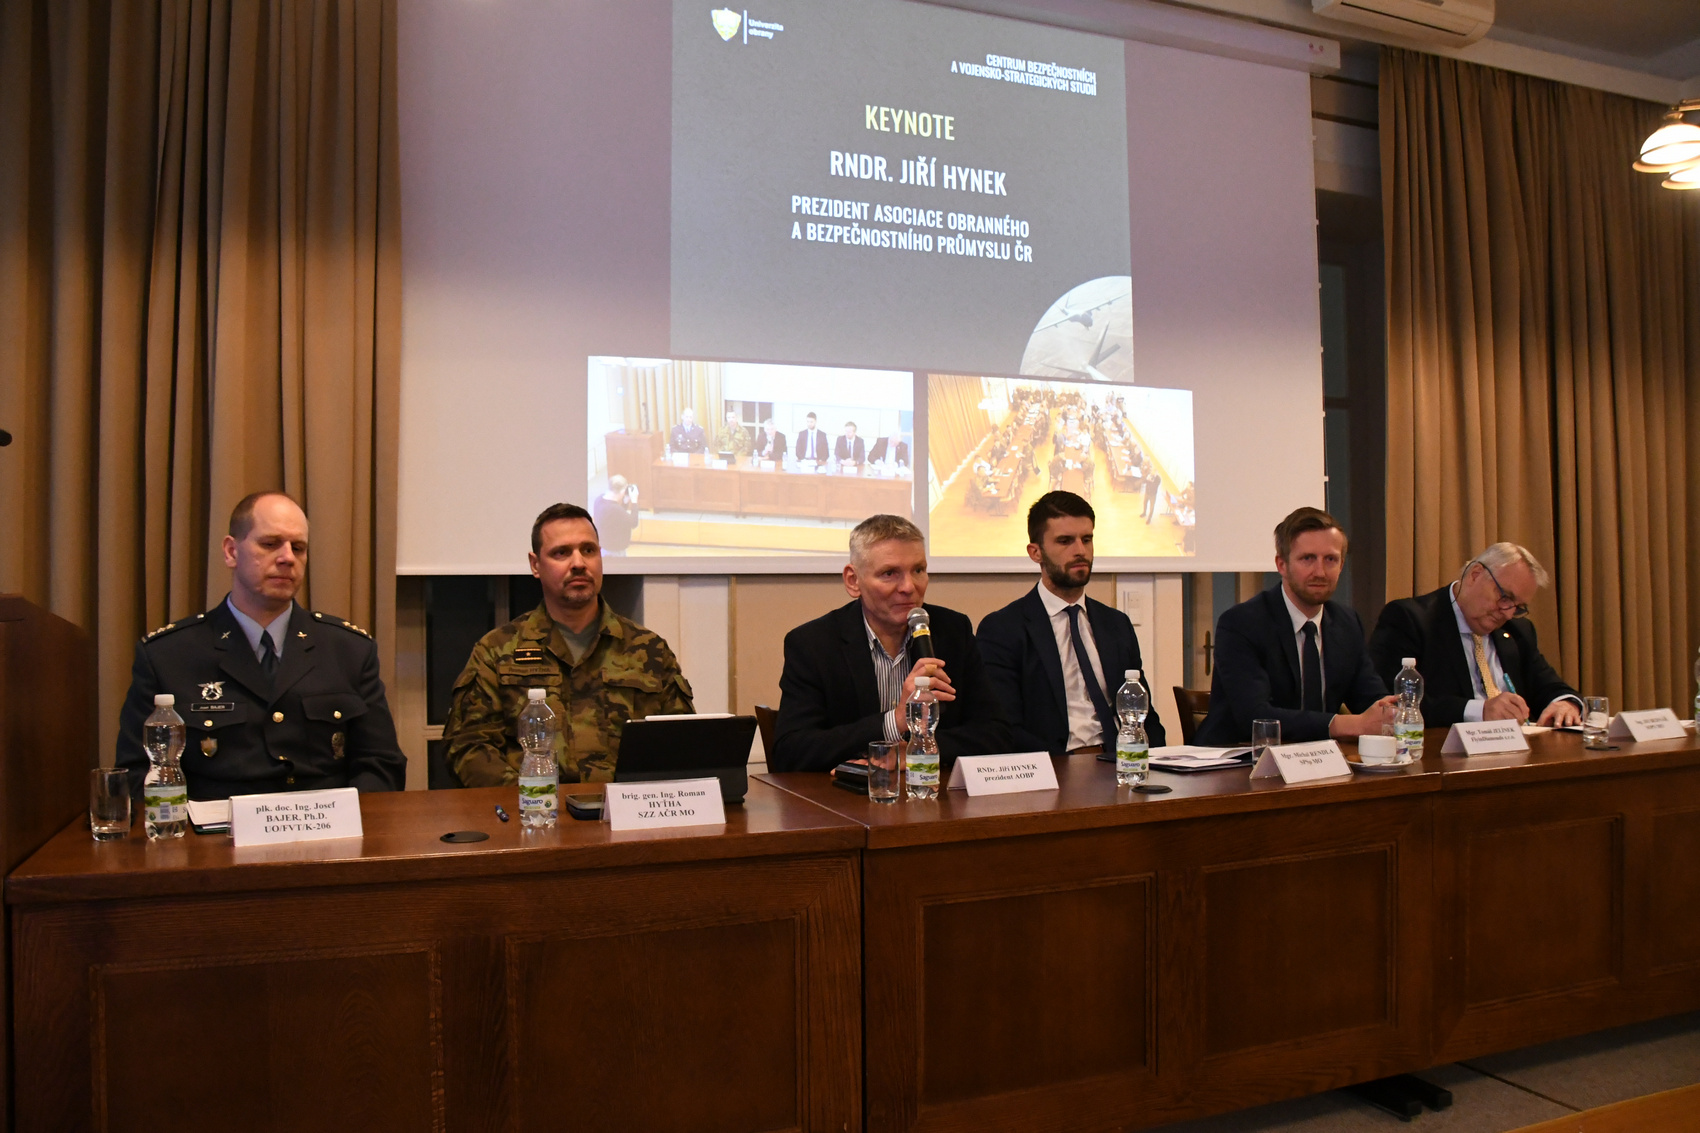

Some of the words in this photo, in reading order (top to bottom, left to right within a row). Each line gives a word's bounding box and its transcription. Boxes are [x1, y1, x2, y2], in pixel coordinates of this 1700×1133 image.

[748, 18, 784, 32] Univerzita
[748, 28, 774, 40] obrany
[986, 53, 1026, 72] CENTRUM
[1027, 60, 1097, 84] BEZPEČNOSTNÍCH
[951, 60, 958, 74] A
[959, 61, 1069, 92] VOJENSKO-STRATEGICKÝCH
[865, 104, 956, 141] KEYNOTE
[830, 150, 894, 183] RNDR.
[899, 155, 937, 188] JIŘÍ
[943, 164, 1008, 197] HYNEK
[791, 195, 870, 221] PREZIDENT
[873, 204, 944, 229] ASOCIACE
[947, 213, 1030, 239] OBRANNÉHO
[791, 221, 802, 240] A
[806, 222, 934, 253] BEZPEČNOSTNÍHO
[937, 233, 1011, 261] PRŮMYSLU
[1014, 239, 1033, 263] ČR
[999, 765, 1010, 773] Jiří
[1010, 763, 1038, 772] HYNEK
[984, 774, 1014, 783] prezident
[1015, 772, 1035, 780] AOBP
[621, 792, 641, 801] brig.
[642, 792, 659, 801] gen.
[660, 791, 676, 799] Ing.
[677, 790, 706, 798] Roman
[255, 804, 273, 815] plk.
[274, 804, 293, 812] doc.
[294, 803, 312, 812] Ing.
[313, 801, 336, 811] Josef
[648, 799, 682, 809] HYŤHA
[266, 813, 302, 823] BAJER,
[303, 812, 328, 821] Ph.D.
[637, 811, 656, 819] SZZ
[658, 808, 678, 818] AČR
[679, 809, 695, 817] MO
[264, 822, 332, 834] UO/FVT/K-206
